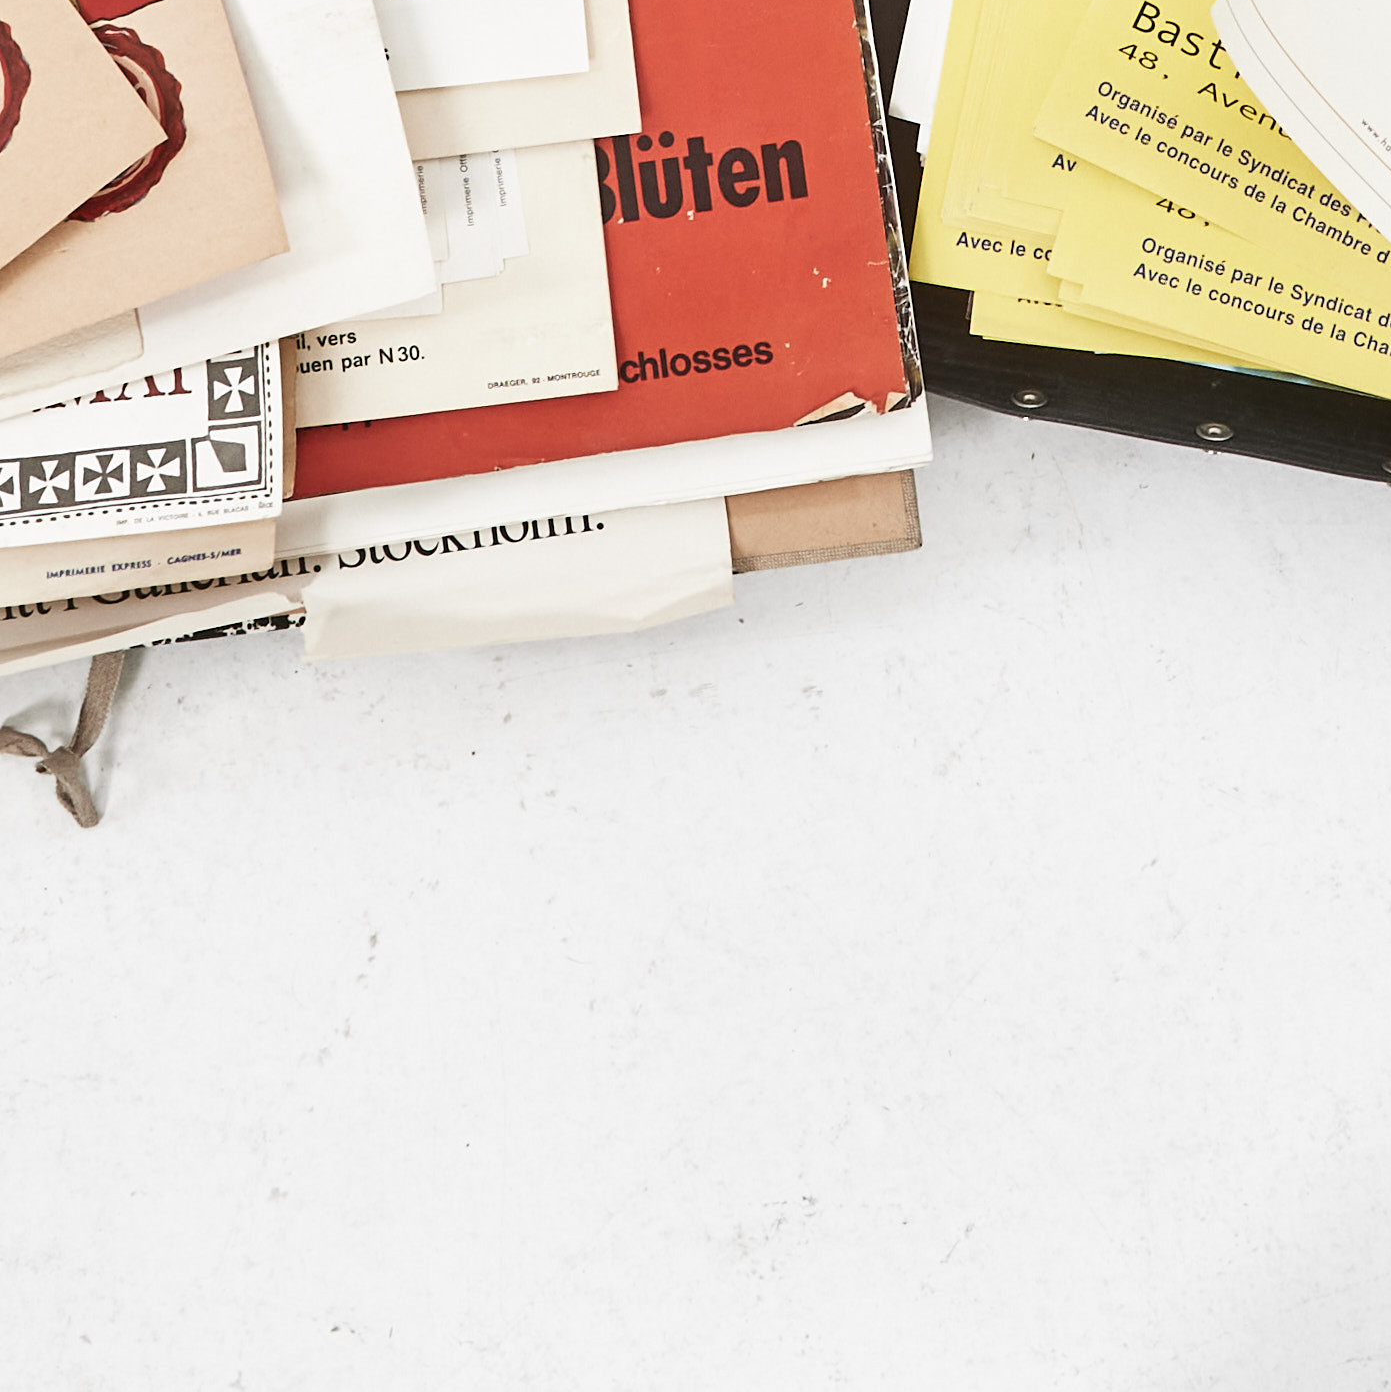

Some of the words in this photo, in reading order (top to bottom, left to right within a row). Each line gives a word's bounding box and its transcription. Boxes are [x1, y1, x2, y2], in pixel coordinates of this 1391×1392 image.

[1117, 42, 1171, 80] 48,
[1096, 80, 1180, 131] Organisé
[1179, 124, 1213, 148] par
[1215, 138, 1234, 157] le
[1236, 149, 1316, 200] Syndicat
[1319, 191, 1352, 217] des
[460, 176, 475, 226] Imprimerie
[492, 155, 509, 206] Imprimerie
[1084, 103, 1131, 135] Avec
[1134, 126, 1152, 146] le
[1156, 141, 1239, 190] concours
[1243, 182, 1266, 203] de
[1269, 194, 1288, 214] la
[1291, 205, 1372, 256] Chambre
[955, 231, 1003, 254] Avec
[1009, 239, 1027, 257] le
[1132, 262, 1180, 289] Avec
[1185, 277, 1203, 296] le
[1208, 288, 1295, 326] concours
[1301, 315, 1324, 335] de
[1329, 323, 1347, 342] la
[1140, 237, 1226, 277] Organisé
[1229, 268, 1263, 288] par
[1267, 275, 1285, 295] le
[1290, 283, 1373, 323] Syndicat
[316, 331, 356, 348] vers
[341, 353, 371, 373] par
[547, 368, 600, 382] MONTROUGE
[46, 565, 105, 579] IMPRIMERIE
[111, 559, 152, 572] EXPRESS
